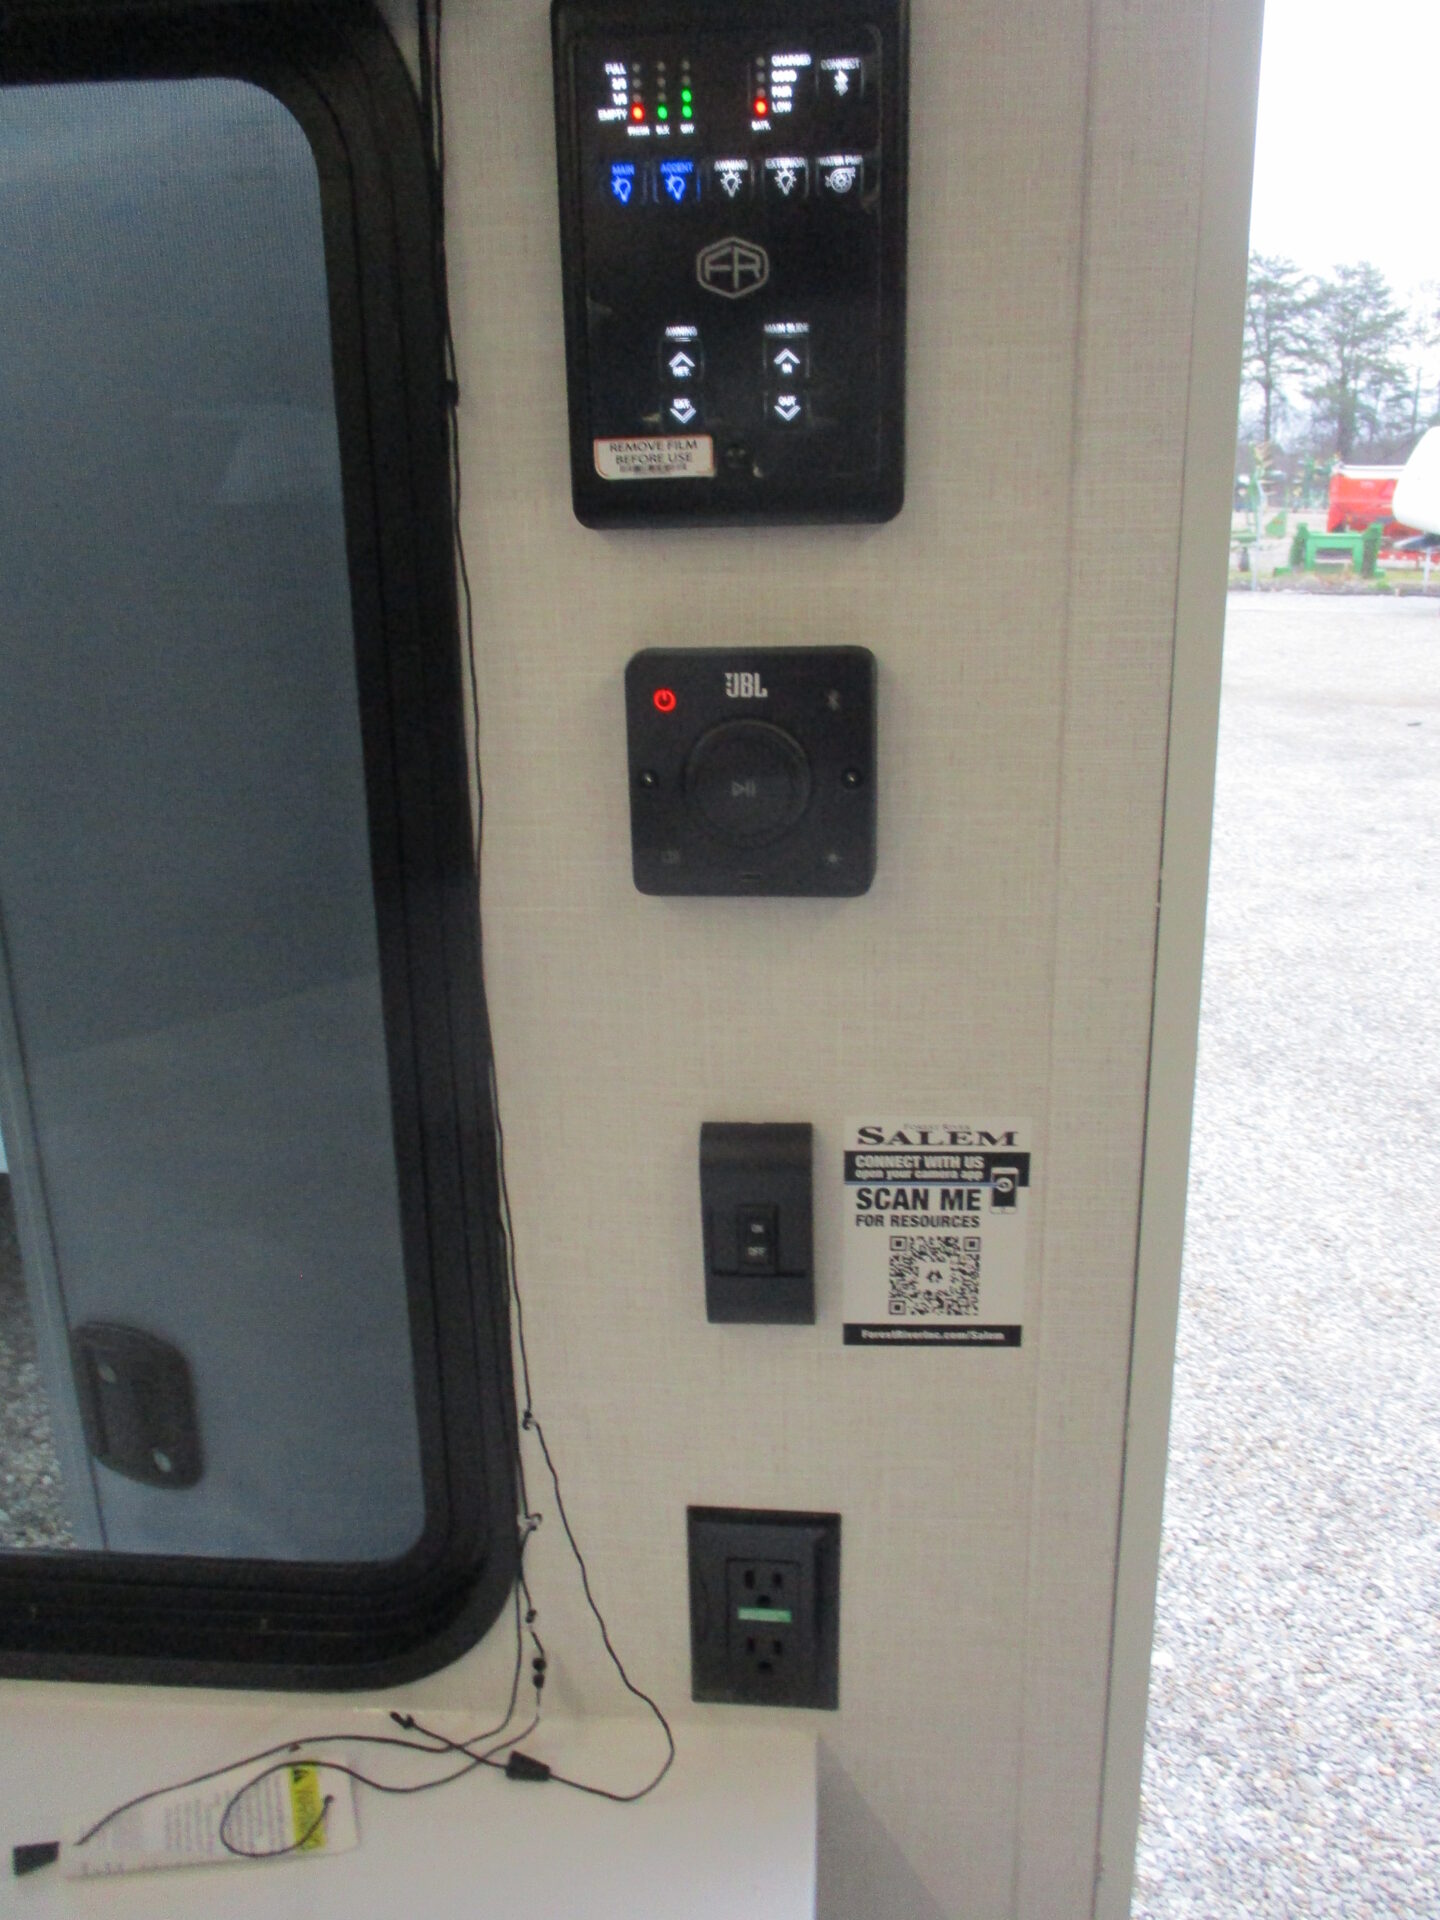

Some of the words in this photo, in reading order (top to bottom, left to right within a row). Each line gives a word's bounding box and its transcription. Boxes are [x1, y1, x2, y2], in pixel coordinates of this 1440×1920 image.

[771, 54, 811, 67] CHARGED
[820, 58, 861, 70] CONNECT
[605, 63, 626, 75] FULL
[772, 101, 792, 113] LOW
[598, 109, 627, 121] EMPTY
[660, 160, 694, 174] ACCENT
[714, 159, 748, 171] AWNING
[765, 157, 806, 168] EXTERIOR
[611, 163, 635, 176] MAIN
[665, 326, 697, 337] AWNING
[764, 323, 785, 333] MAIN
[781, 363, 792, 374] IN
[778, 396, 796, 407] OUT
[609, 440, 664, 452] REMOVE
[667, 439, 698, 450] FILM
[616, 453, 664, 465] BEFORE
[668, 452, 693, 463] USE
[725, 672, 768, 698] JBL
[857, 1126, 1019, 1147] SALEM
[855, 1155, 922, 1169] CONNECT
[923, 1156, 960, 1169] WITH
[964, 1156, 985, 1169] US
[856, 1188, 929, 1211] SCAN
[940, 1188, 982, 1211] ME
[856, 1214, 885, 1227] FOR
[890, 1215, 980, 1228] RESOURCES
